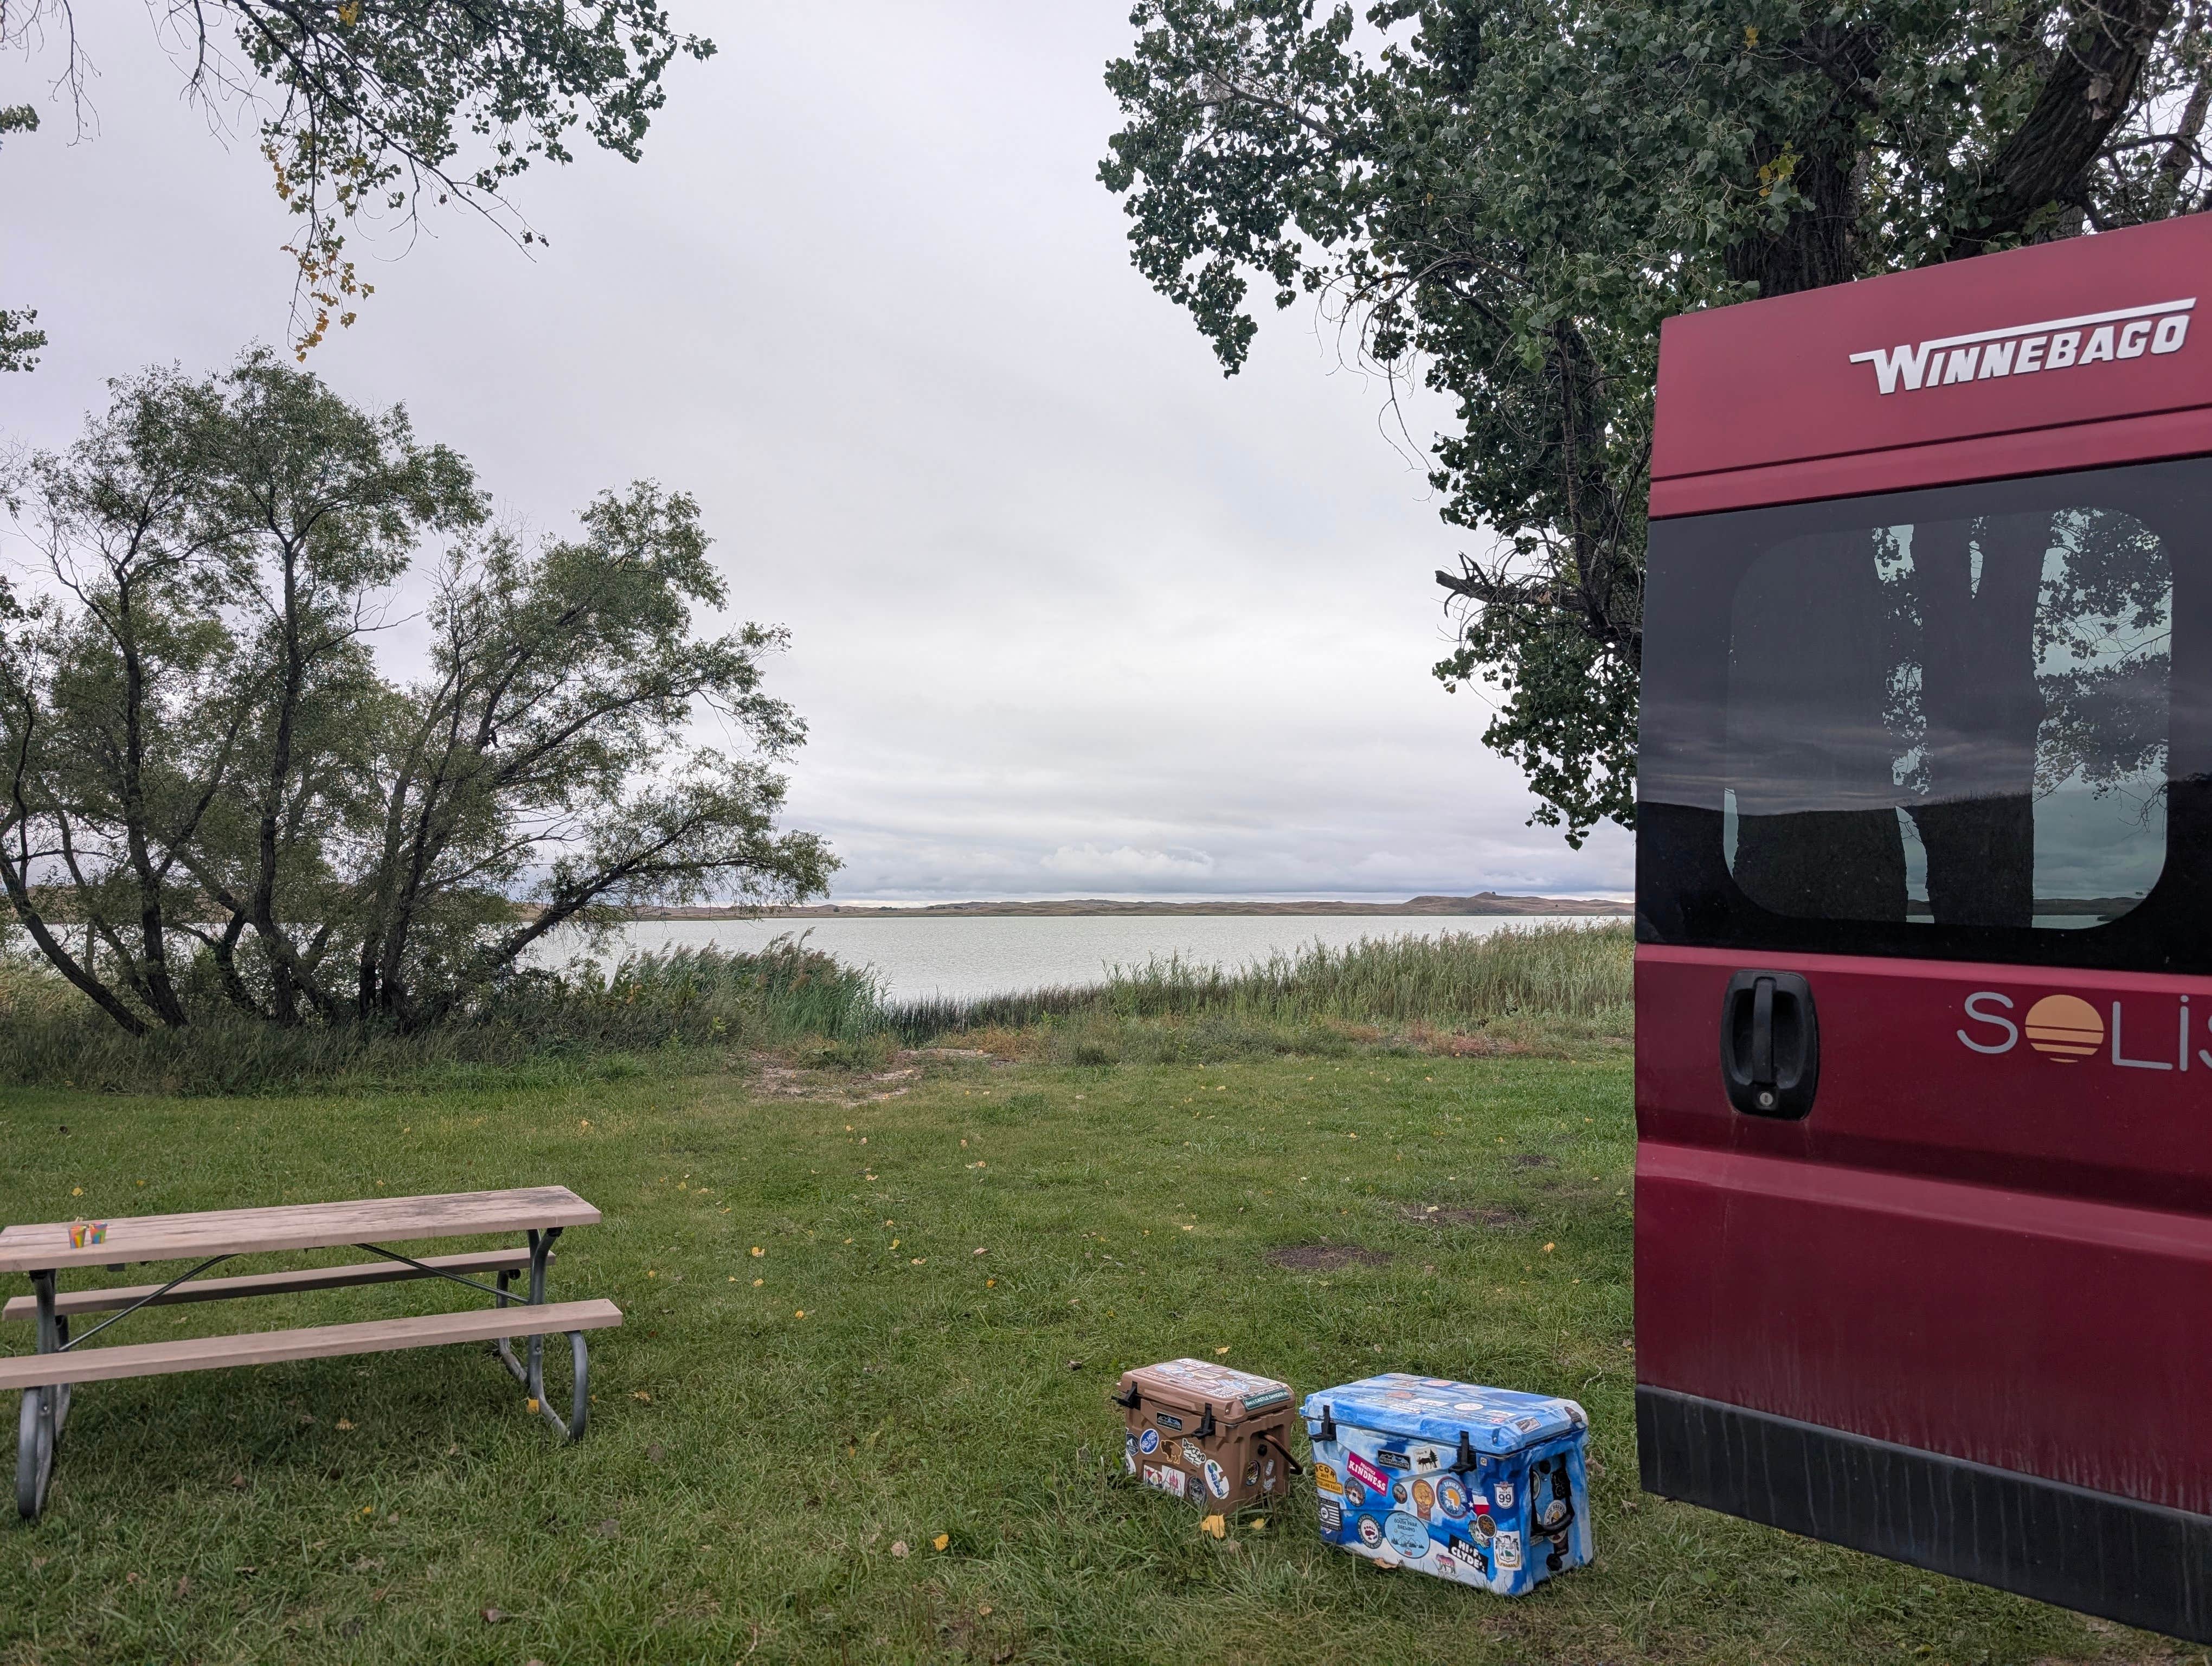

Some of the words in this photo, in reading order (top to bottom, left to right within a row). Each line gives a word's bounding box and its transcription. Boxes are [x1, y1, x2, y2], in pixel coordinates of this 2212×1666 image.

[1849, 297, 2196, 394] WINNEBAGO
[1253, 1394, 1269, 1404] CASTLE
[1269, 1392, 1285, 1401] DANGER
[1182, 1439, 1206, 1462] DESCEND
[1348, 1460, 1386, 1491] KINDNESS
[1360, 1462, 1376, 1476] PRACTICE
[1443, 1481, 1459, 1490] DENVER
[1458, 1486, 1466, 1501] BEER
[1498, 1494, 1512, 1503] 99
[1397, 1524, 1416, 1533] BREWING
